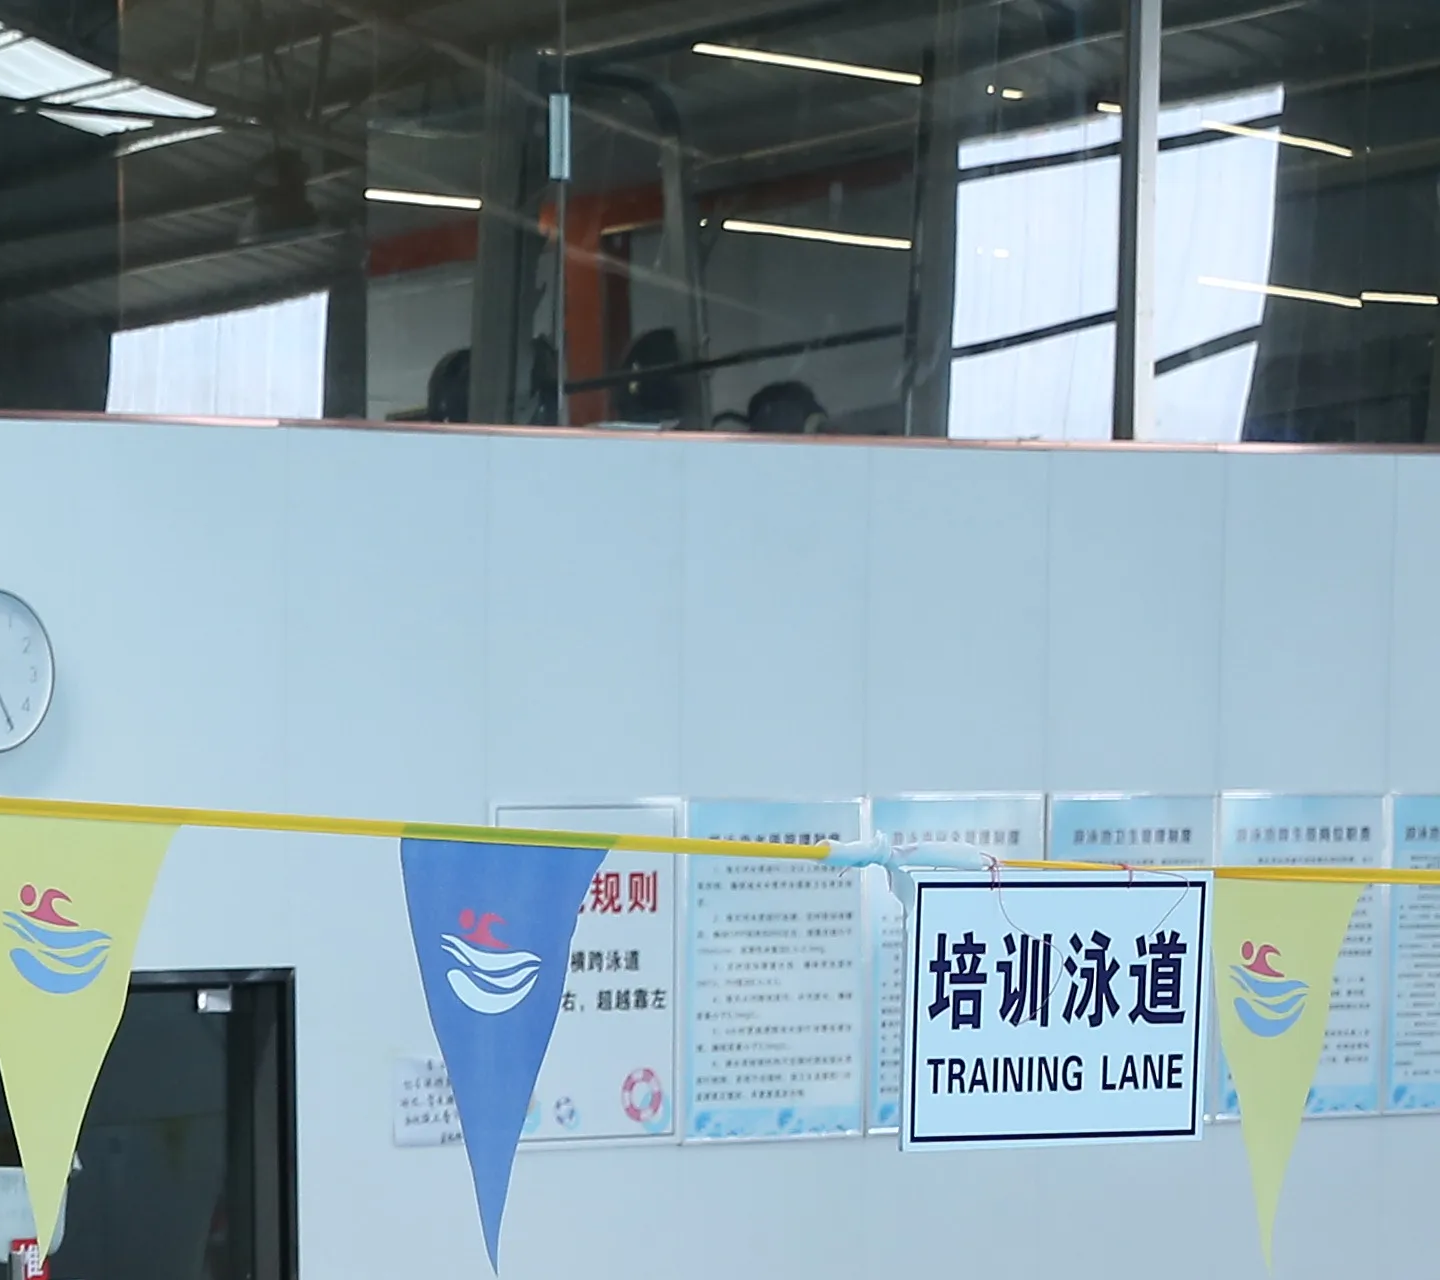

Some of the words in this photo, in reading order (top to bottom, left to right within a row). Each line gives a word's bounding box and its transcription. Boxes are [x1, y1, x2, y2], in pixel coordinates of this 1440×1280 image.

[578, 869, 658, 914] 规则
[927, 929, 1188, 1030] 培训泳道
[927, 1055, 1083, 1094] TRAINING
[1101, 1053, 1184, 1091] LANE
